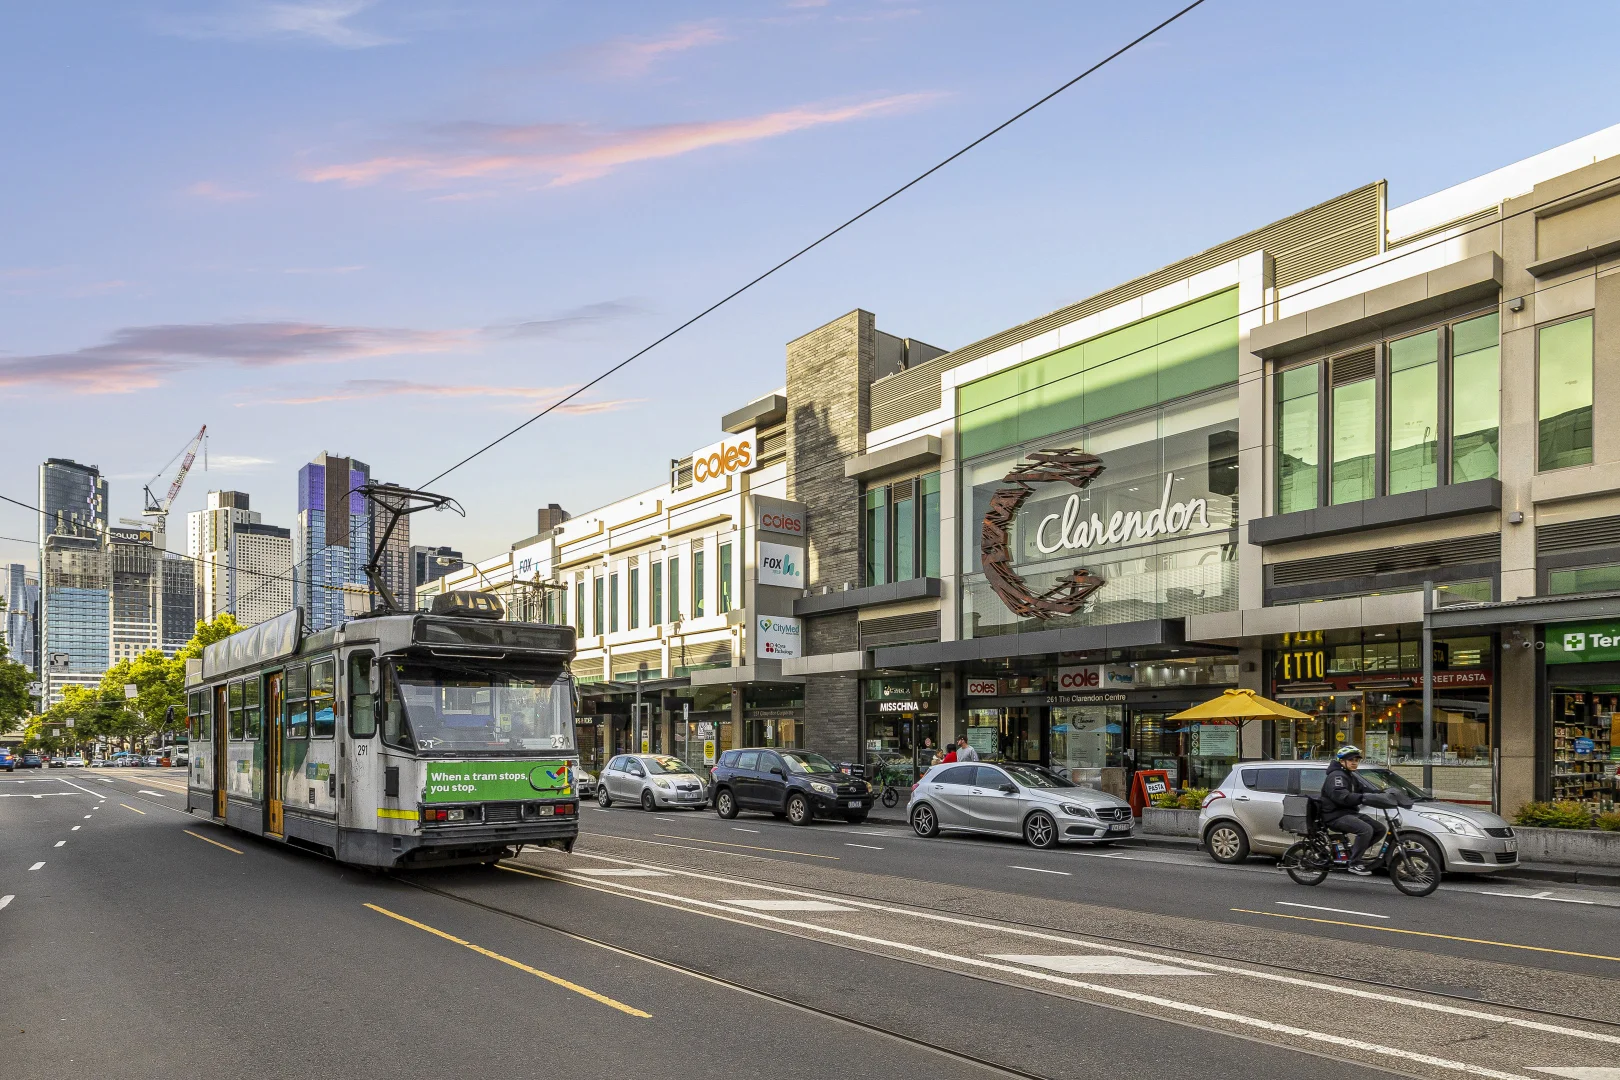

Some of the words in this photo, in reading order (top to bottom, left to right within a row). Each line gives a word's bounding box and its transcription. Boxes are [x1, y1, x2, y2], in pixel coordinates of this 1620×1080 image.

[694, 441, 752, 483] coles
[1036, 473, 1210, 554] Clarendon
[762, 513, 802, 532] coles
[519, 558, 532, 574] FOX
[763, 557, 783, 570] FOX
[773, 623, 800, 634] CityMed
[1589, 633, 1620, 647] Ter
[1433, 649, 1445, 662] STA
[1284, 651, 1324, 679] ETTO
[1061, 668, 1100, 688] cole
[1420, 675, 1454, 683] SREET
[1456, 674, 1486, 682] PASTA
[970, 682, 996, 694] coles
[1072, 694, 1104, 702] Clarendon
[1104, 693, 1126, 701] Centre
[357, 744, 368, 756] 291
[431, 772, 462, 781] When
[463, 773, 471, 781] a
[472, 772, 498, 781] tram
[499, 772, 528, 782] stops,
[430, 784, 450, 794] you
[451, 783, 477, 794] stop.
